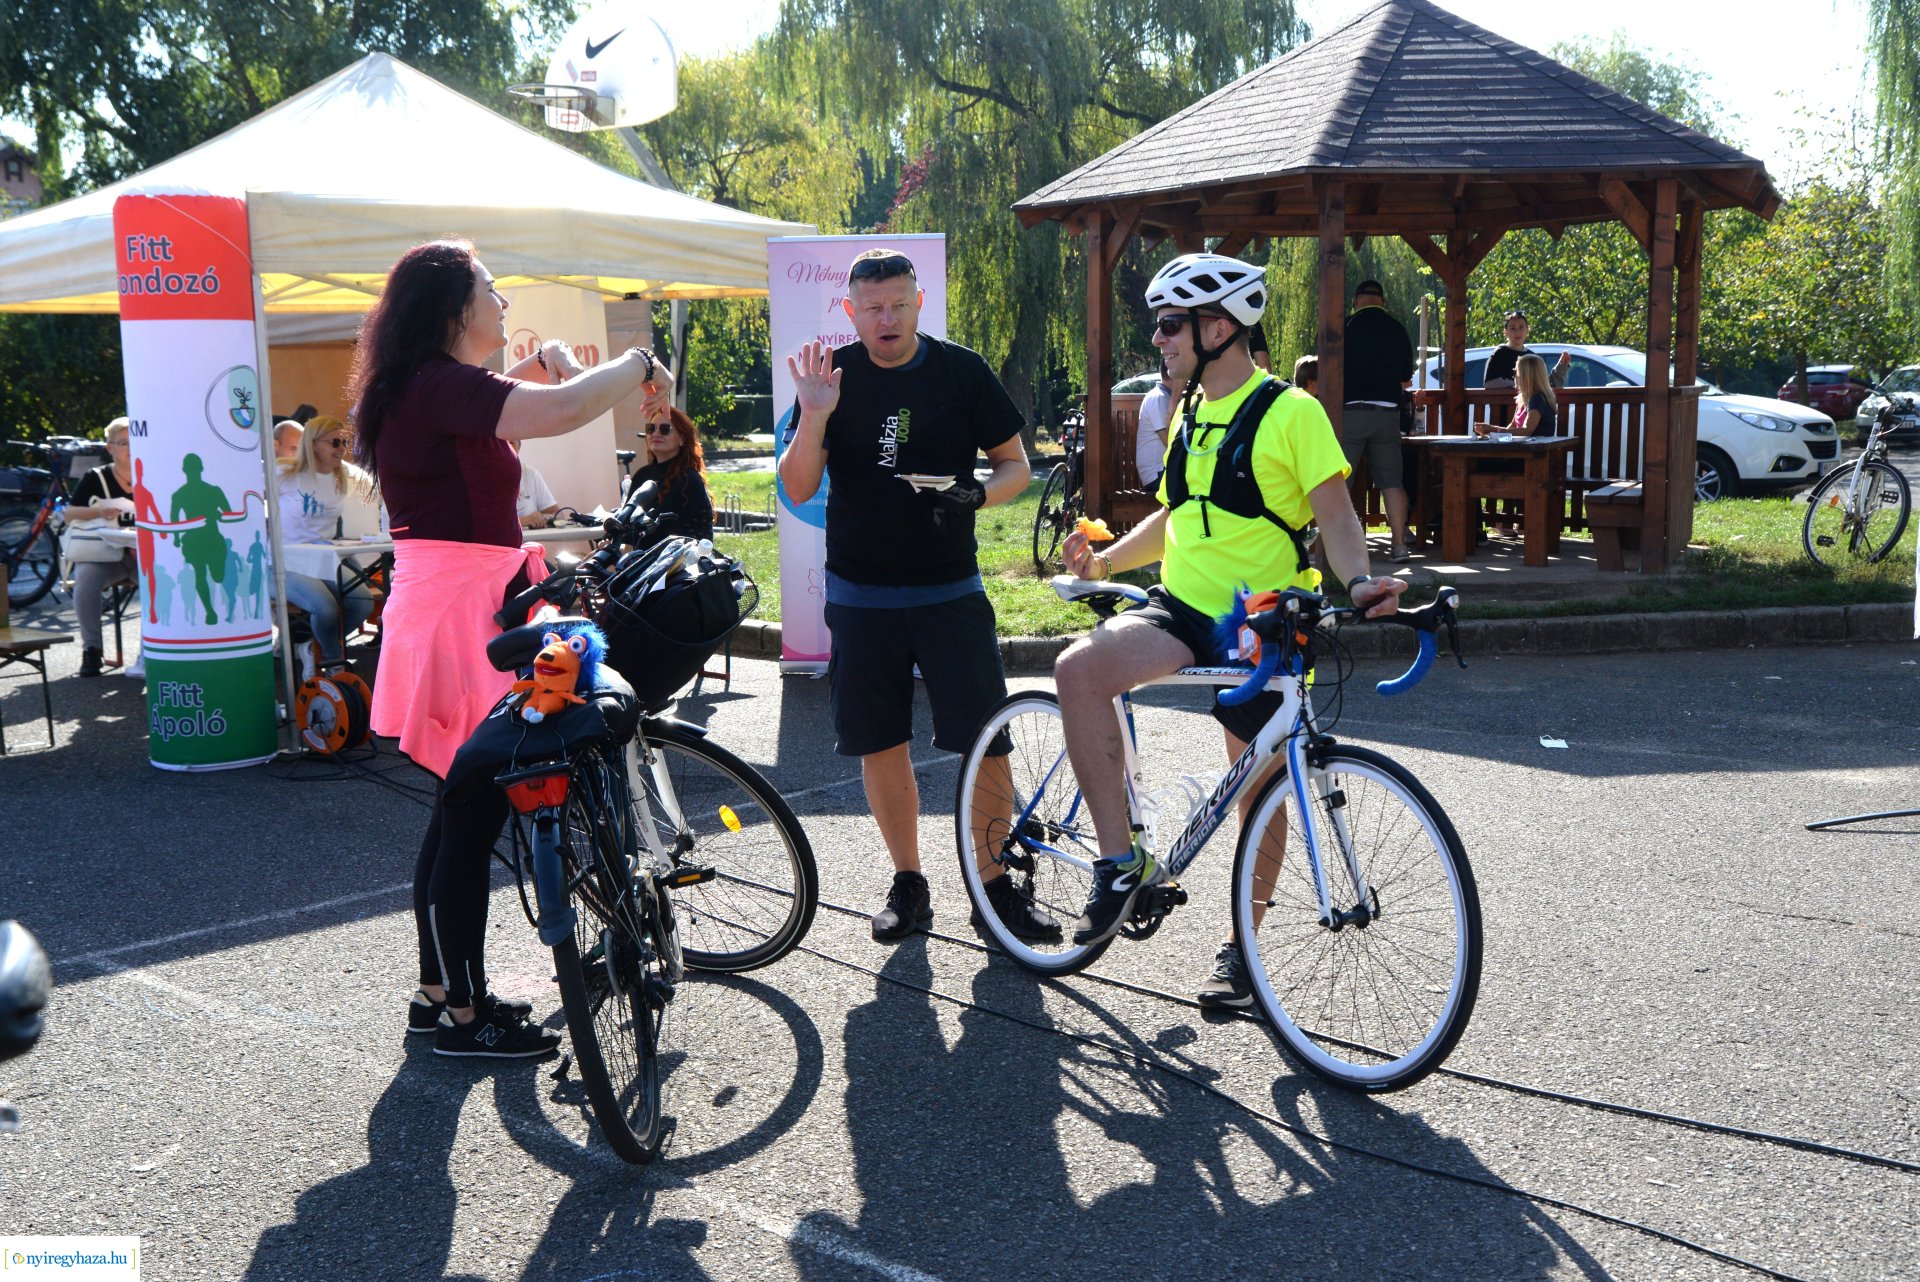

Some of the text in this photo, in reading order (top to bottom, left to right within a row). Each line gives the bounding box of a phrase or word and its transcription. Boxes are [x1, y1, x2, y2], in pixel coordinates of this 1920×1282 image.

[126, 234, 173, 262] Fitt
[118, 266, 220, 295] ondozó
[787, 261, 849, 288] Méhny
[878, 415, 898, 467] Malizia
[897, 408, 911, 443] UOMO
[158, 681, 204, 708] Fitt
[151, 703, 227, 742] Ápoló
[1168, 738, 1258, 865] MERIDA
[1171, 814, 1218, 874] MERIDA
